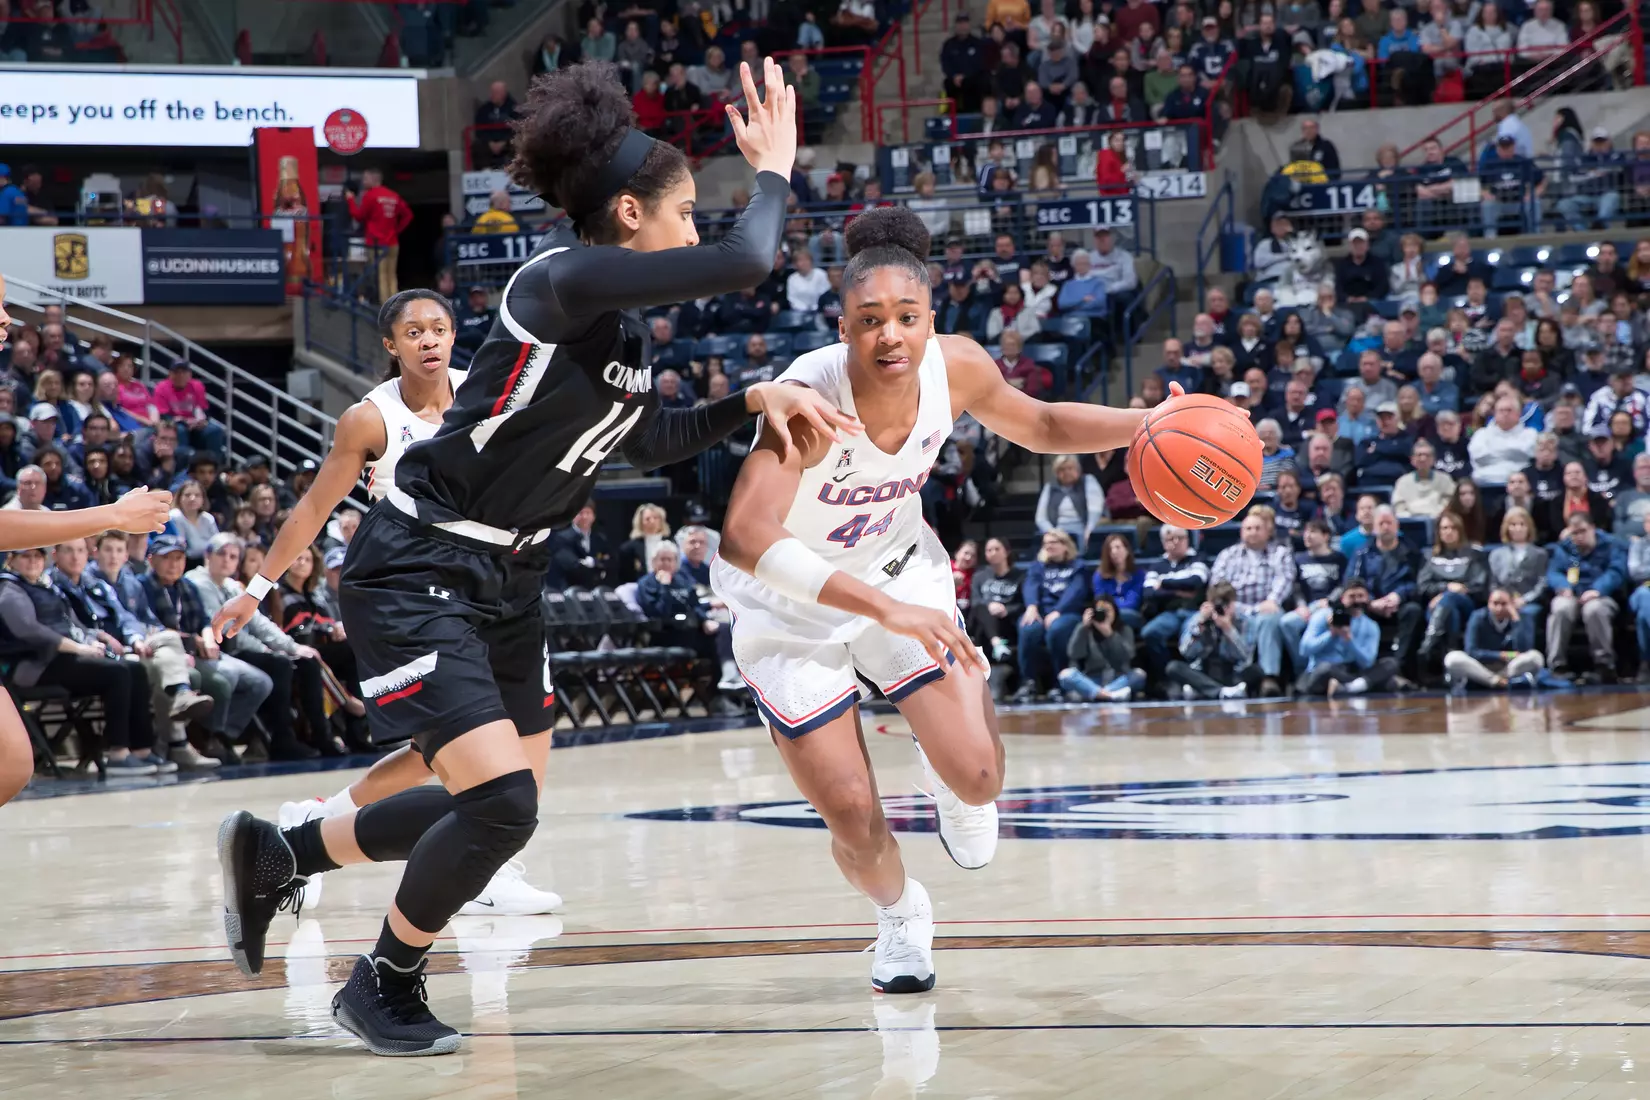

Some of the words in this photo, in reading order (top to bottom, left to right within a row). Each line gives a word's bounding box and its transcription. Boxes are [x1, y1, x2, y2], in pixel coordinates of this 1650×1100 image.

[68, 104, 113, 124] you
[123, 99, 156, 119] off
[166, 99, 205, 120] the
[214, 100, 293, 121] bench.
[1158, 174, 1202, 197] 214
[1326, 185, 1376, 211] 114
[1037, 207, 1072, 224] SEC
[1086, 200, 1132, 225] 113
[458, 242, 489, 258] SEC
[147, 258, 280, 274] @UCONNHUSKIES
[555, 401, 644, 477] 14
[1189, 458, 1243, 503] ELITE
[826, 506, 898, 549] 44
